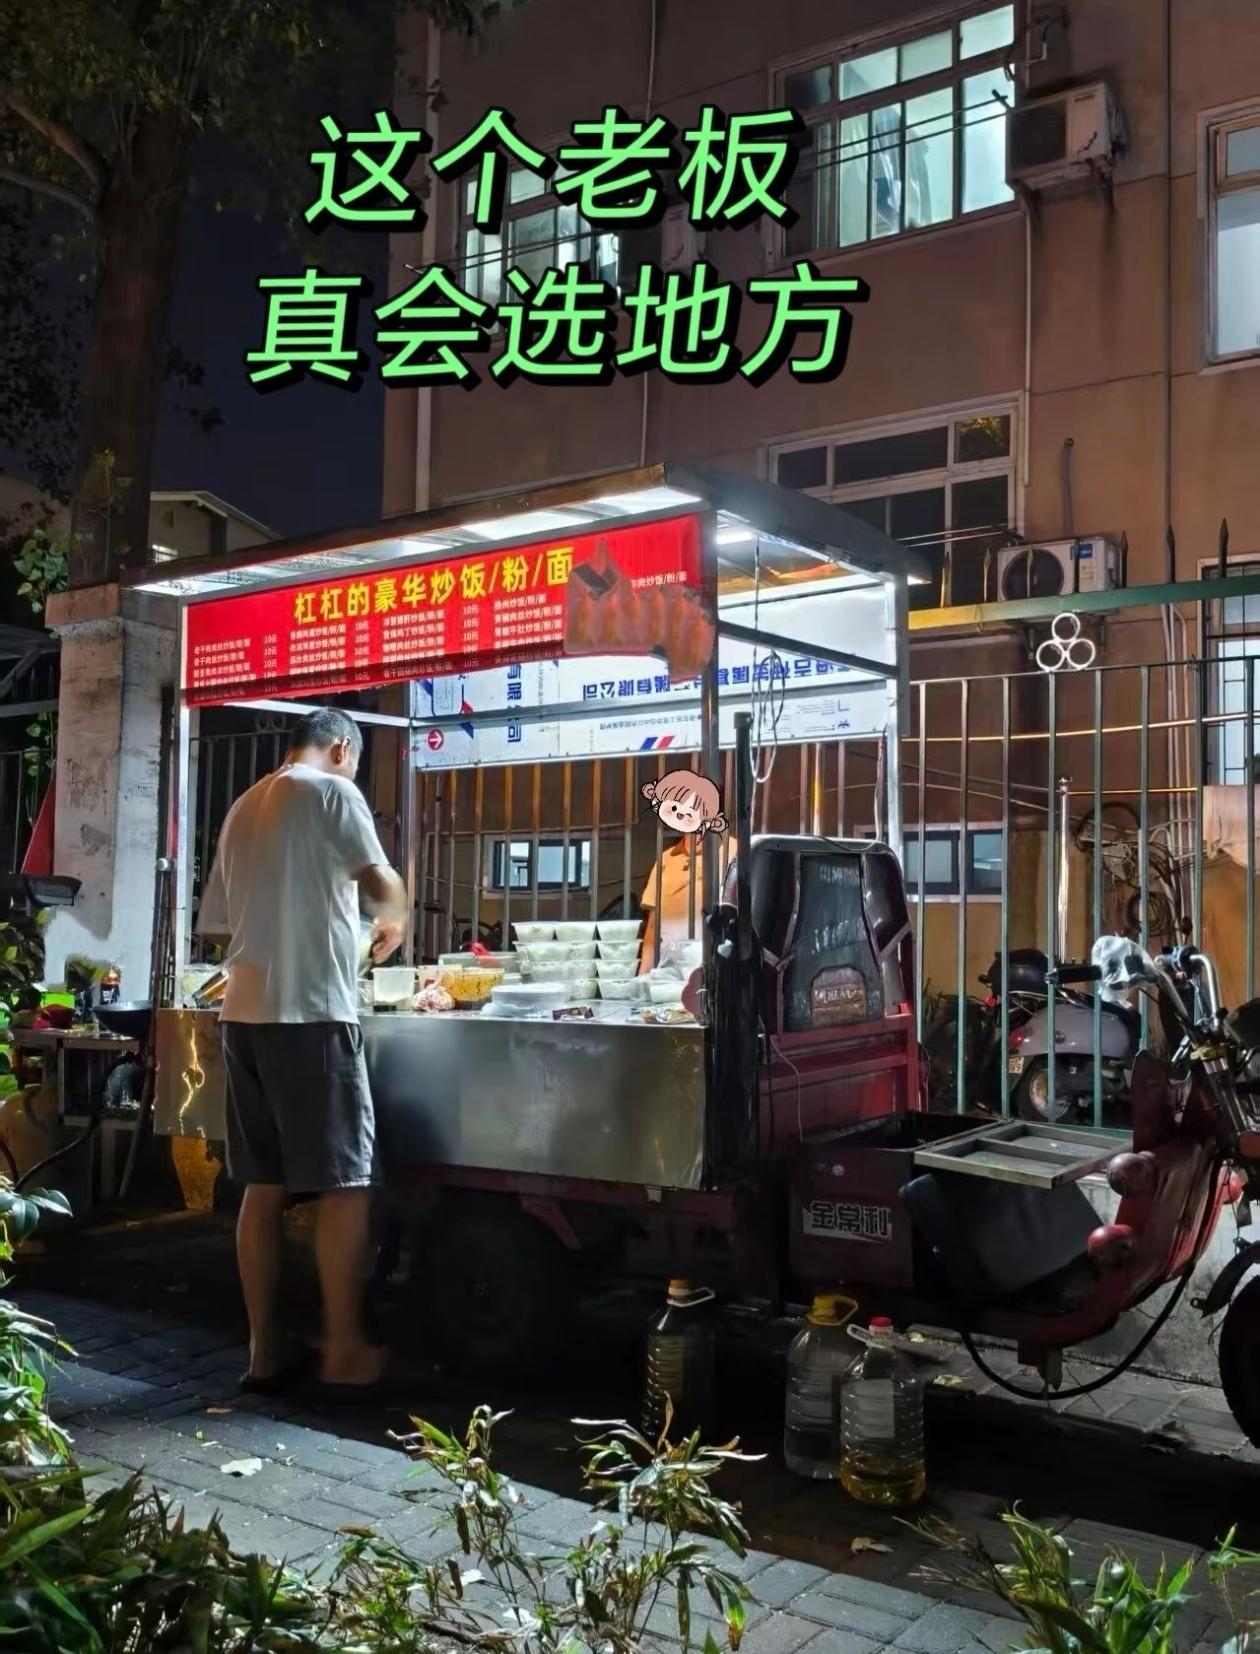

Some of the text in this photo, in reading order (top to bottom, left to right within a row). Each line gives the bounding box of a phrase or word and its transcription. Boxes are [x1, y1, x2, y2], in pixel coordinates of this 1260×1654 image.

[294, 547, 573, 624] 杠杠的豪华炒饭/粉/面
